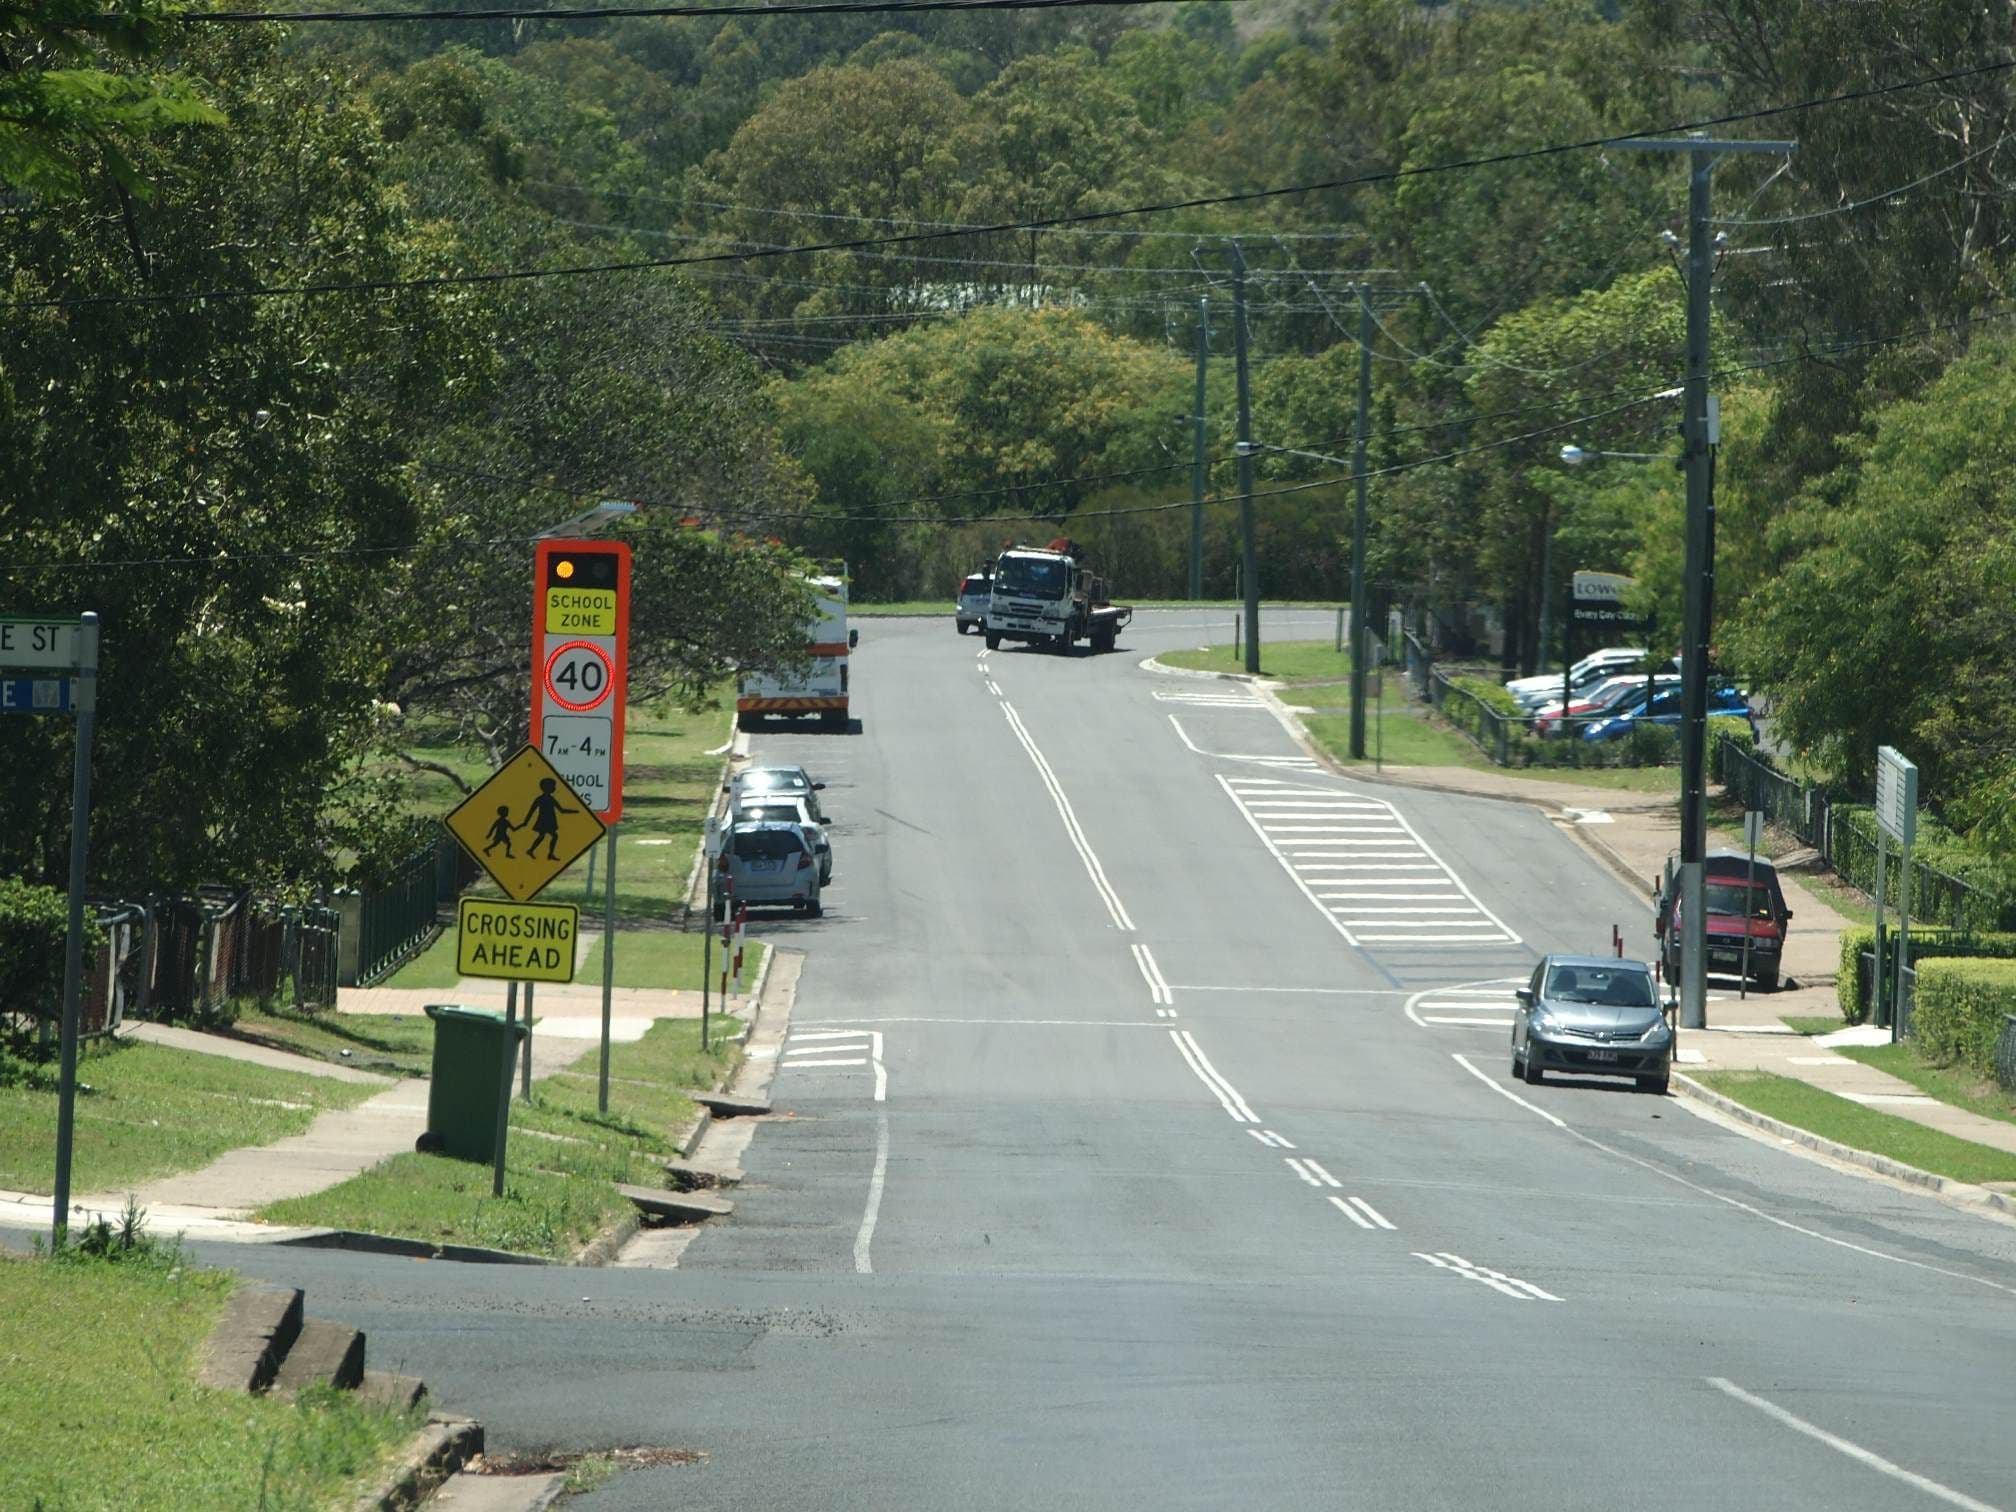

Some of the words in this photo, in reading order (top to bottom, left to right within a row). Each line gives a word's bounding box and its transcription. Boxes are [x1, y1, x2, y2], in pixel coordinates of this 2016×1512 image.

[551, 595, 612, 609] SCHOOL
[561, 614, 601, 627] ZONE
[32, 626, 59, 652] ST
[556, 661, 602, 691] 40
[467, 912, 570, 940] CROSSING
[471, 943, 560, 969] AHEAD
